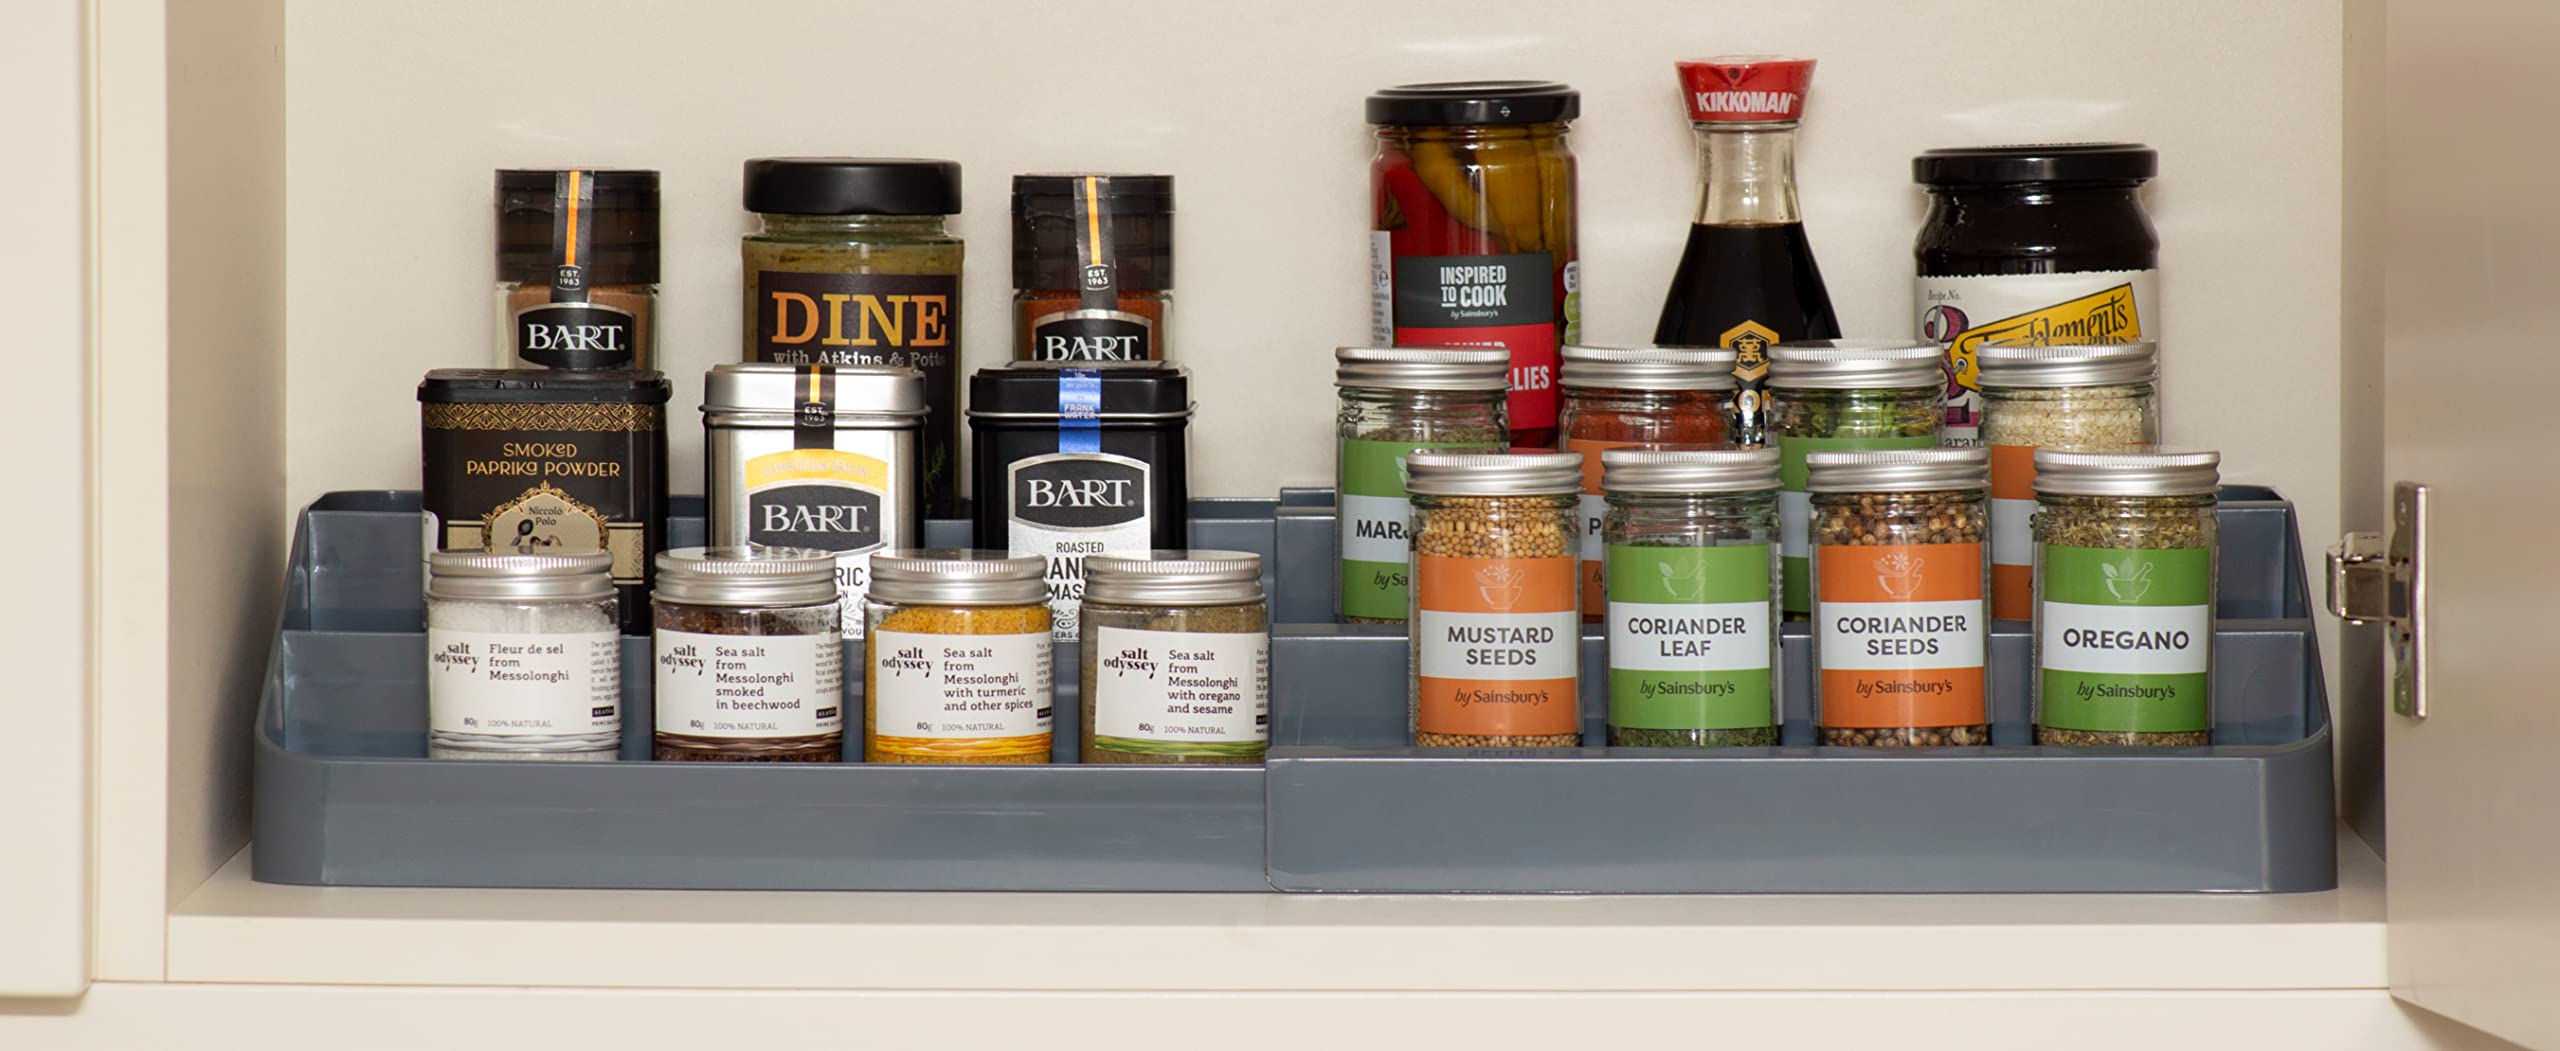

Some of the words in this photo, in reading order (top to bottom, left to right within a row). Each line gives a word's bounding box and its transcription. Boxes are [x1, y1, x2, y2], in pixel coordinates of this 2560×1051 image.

[1696, 92, 1794, 114] KIKKOMAN
[559, 278, 580, 286] 1963
[1088, 277, 1108, 285] 1963
[1440, 265, 1507, 285] INSPIRED
[1441, 286, 1457, 304] TO
[1460, 285, 1507, 307] COOK
[771, 291, 947, 347] DINE
[1451, 310, 1460, 320] by
[1460, 309, 1499, 319] Sainsbury's
[526, 323, 622, 351] BART
[1045, 335, 1138, 360] BART
[773, 350, 809, 365] with
[817, 350, 883, 366] Atkins
[889, 352, 904, 366] &
[544, 462, 621, 477] POWDER
[1027, 479, 1131, 507] BART
[535, 516, 557, 526] Polo
[762, 504, 867, 533] BART
[1056, 541, 1104, 554] ROASTED
[1374, 570, 1390, 590] by
[1628, 617, 1747, 635] CORIANDER
[1837, 615, 1967, 634] CORIANDER
[1448, 626, 1554, 643] MUSTARD
[2063, 628, 2190, 650] OREGANO
[447, 642, 470, 654] salt
[489, 643, 523, 654] Fleur
[528, 643, 542, 654] de
[546, 643, 564, 654] sel
[673, 645, 697, 657] salt
[715, 647, 738, 657] Sea
[741, 647, 765, 657] salt
[897, 647, 923, 659] salt
[943, 648, 966, 658] Sea
[969, 648, 992, 658] salt
[1121, 648, 1148, 660] salt
[1660, 640, 1712, 657] LEAF
[1866, 638, 1940, 656] SEEDS
[489, 656, 520, 668] from
[1168, 650, 1190, 660] Sea
[1193, 650, 1215, 660] salt
[1466, 649, 1537, 666] SEEDS
[434, 652, 480, 673] odyssey
[660, 654, 706, 676] odyssey
[715, 659, 746, 671] from
[882, 656, 934, 678] odyssey
[943, 660, 975, 671] from
[1103, 657, 1159, 679] odyssey
[1168, 663, 1198, 674] from
[489, 670, 569, 683] Messolonghi
[715, 672, 794, 686] Messolonghi
[944, 672, 1019, 686] Messolonghi
[1168, 676, 1238, 690] Messolonghi
[716, 686, 764, 697] smoked
[944, 686, 973, 698] with
[977, 685, 1026, 697] turmeric
[1640, 680, 1656, 699] by
[1658, 680, 1735, 696] Sainsbury's
[1856, 679, 1874, 698] by
[1875, 679, 1953, 696] Sainsbury's
[2077, 681, 2096, 701] by
[2096, 683, 2176, 699] Sainsbury's
[1167, 690, 1195, 700] with
[1199, 692, 1241, 704] oregano
[1455, 688, 1473, 707] by
[1473, 689, 1549, 705] Sainsbury's
[716, 699, 728, 710] in
[732, 699, 801, 710] beechwood
[944, 700, 967, 711] and
[970, 700, 1001, 711] other
[1005, 699, 1033, 712] spices
[1167, 703, 1189, 714] and
[1193, 704, 1233, 714] sesame
[511, 720, 552, 728] NATURAL
[737, 722, 778, 730] NATURAL
[966, 722, 1004, 731] NATURAL
[1188, 726, 1226, 735] NATURAL
